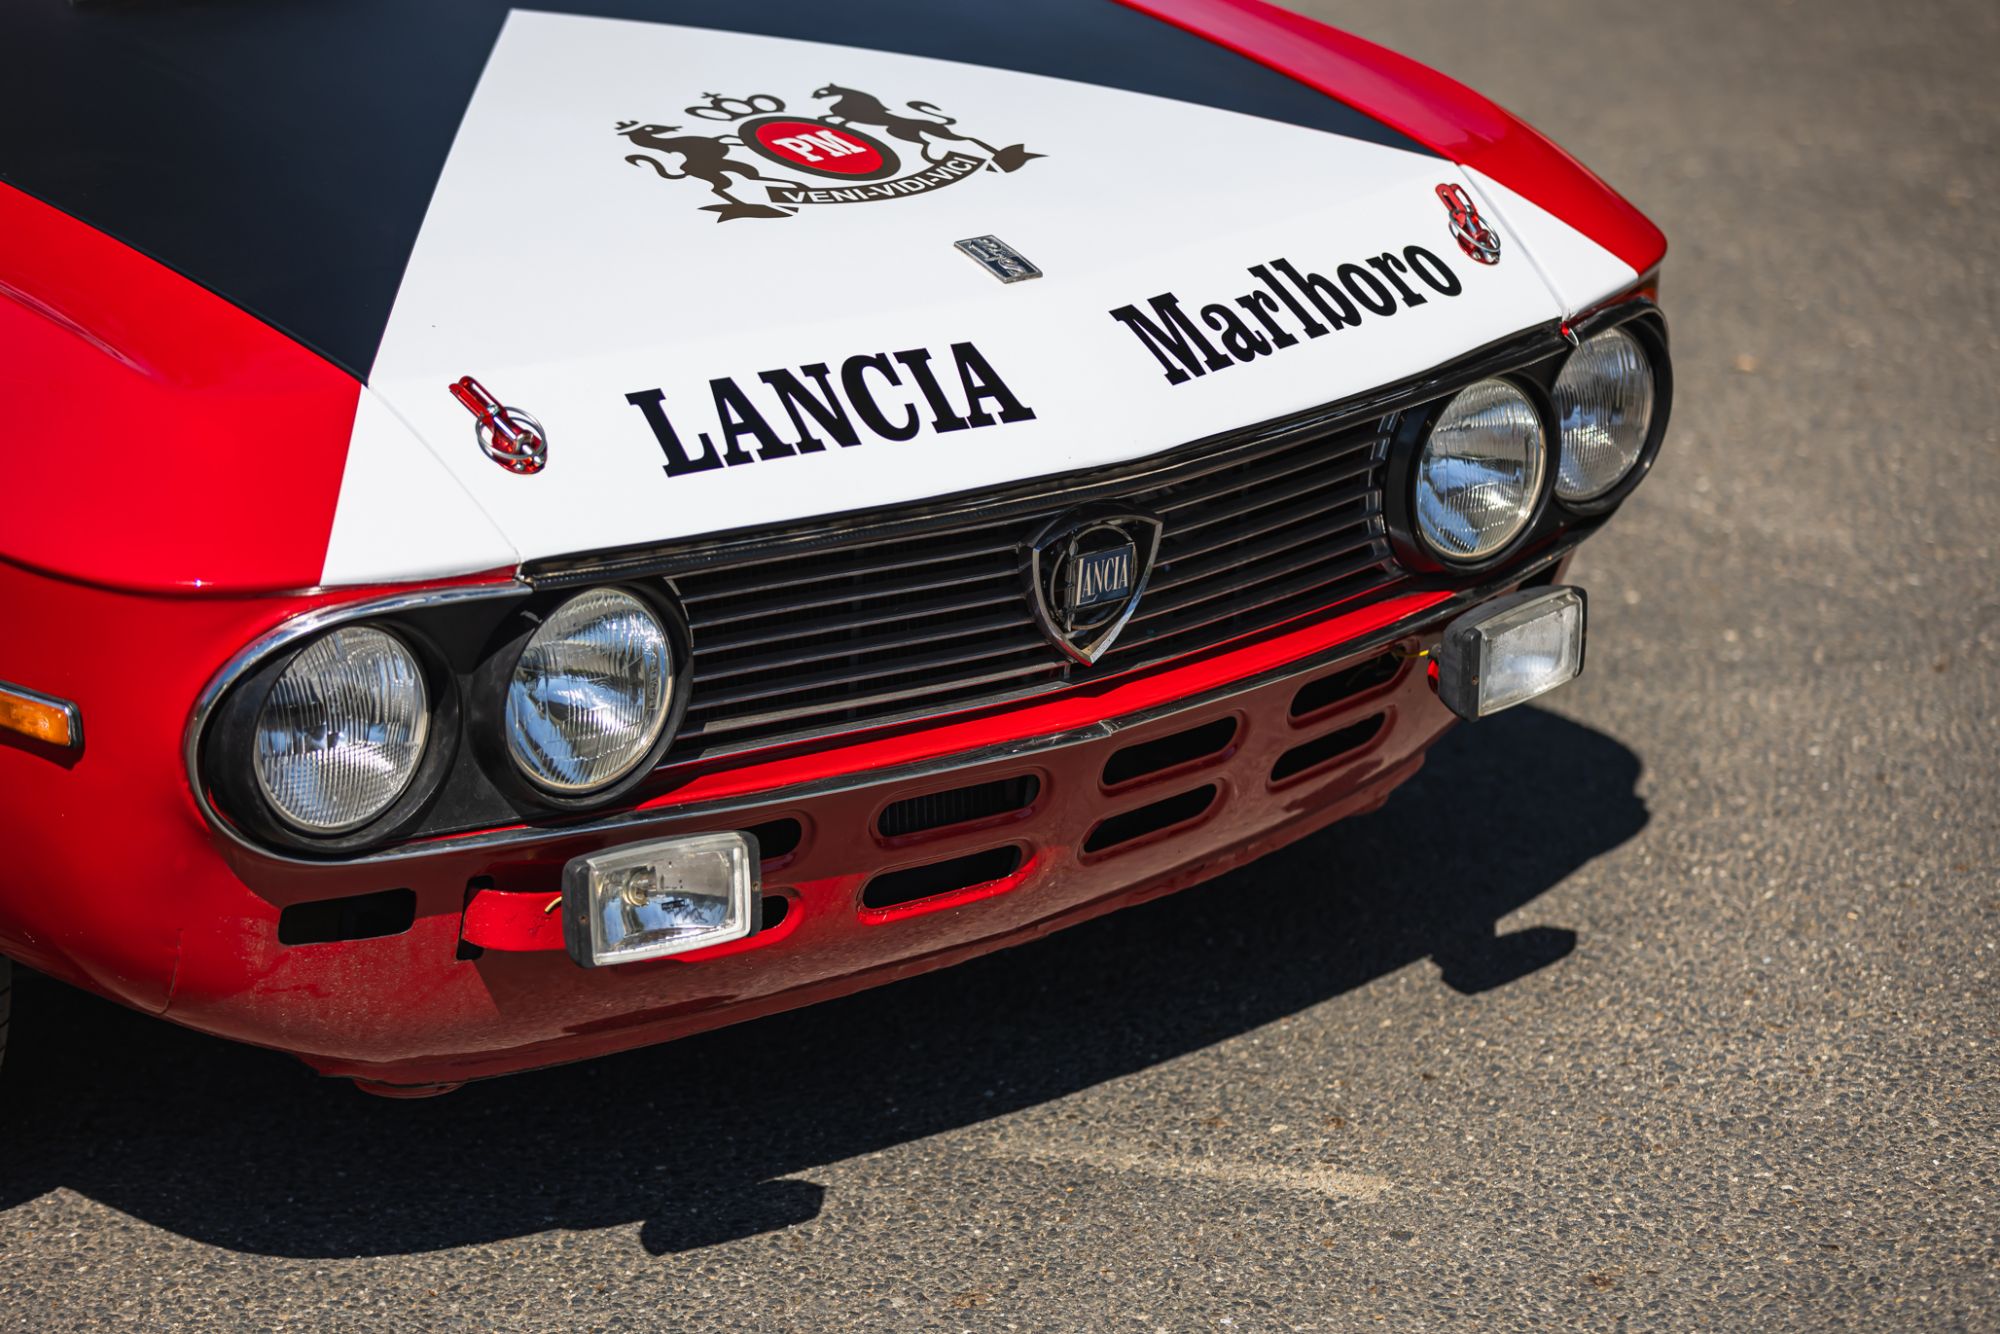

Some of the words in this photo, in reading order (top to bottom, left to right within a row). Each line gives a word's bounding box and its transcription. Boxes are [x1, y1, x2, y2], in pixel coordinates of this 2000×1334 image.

[772, 130, 867, 163] PM
[782, 157, 978, 203] VENI-VIDI-VICI
[1109, 246, 1462, 386] Marlboro
[625, 342, 1037, 478] LANCIA
[1076, 554, 1128, 606] LANCIA
